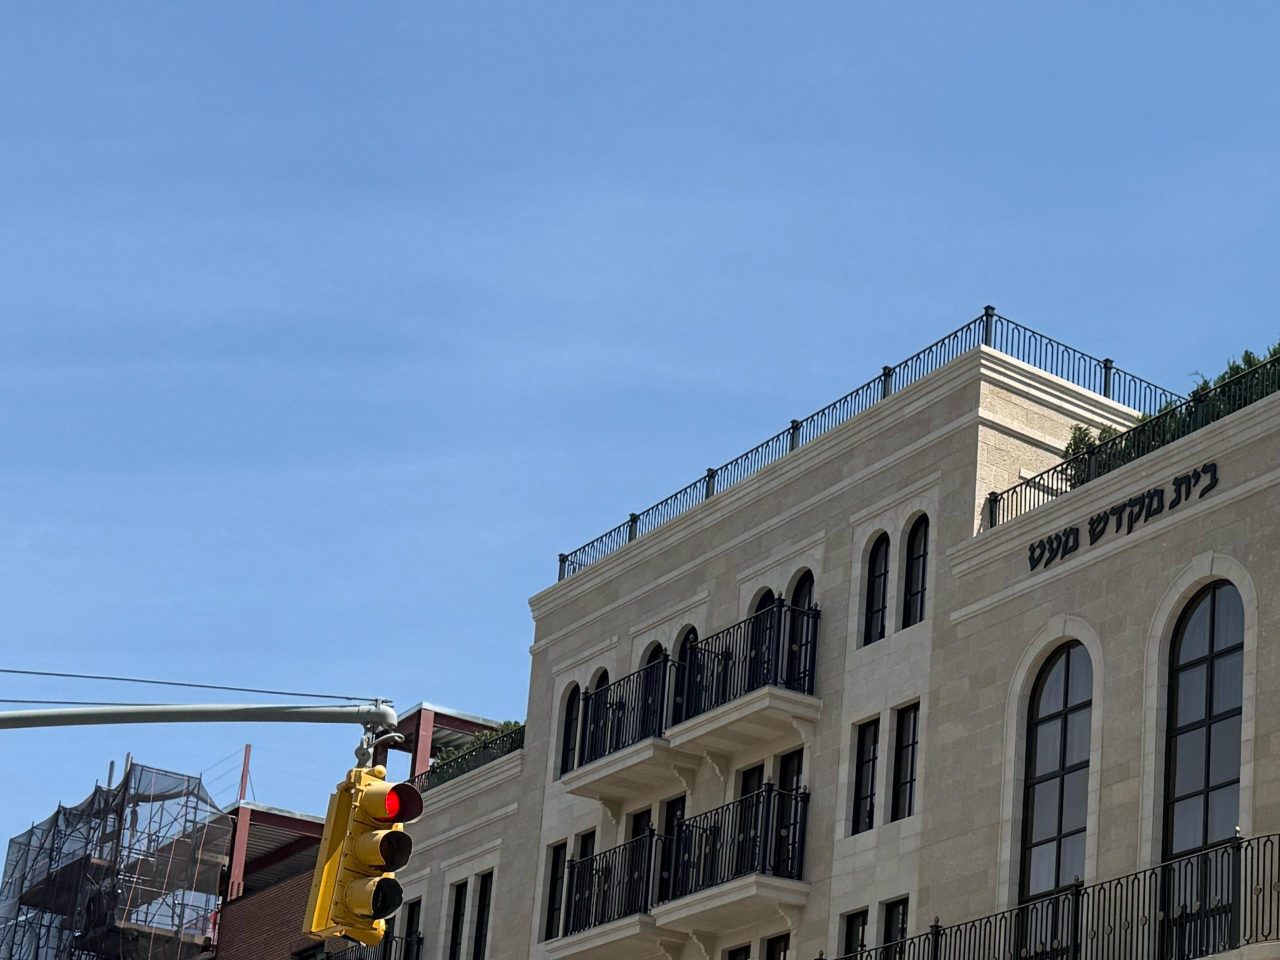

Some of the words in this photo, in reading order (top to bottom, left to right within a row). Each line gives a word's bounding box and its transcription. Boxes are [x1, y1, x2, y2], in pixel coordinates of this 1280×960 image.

[1169, 462, 1219, 510] בית
[1088, 487, 1165, 546] מקדש
[1028, 526, 1080, 572] מעט
